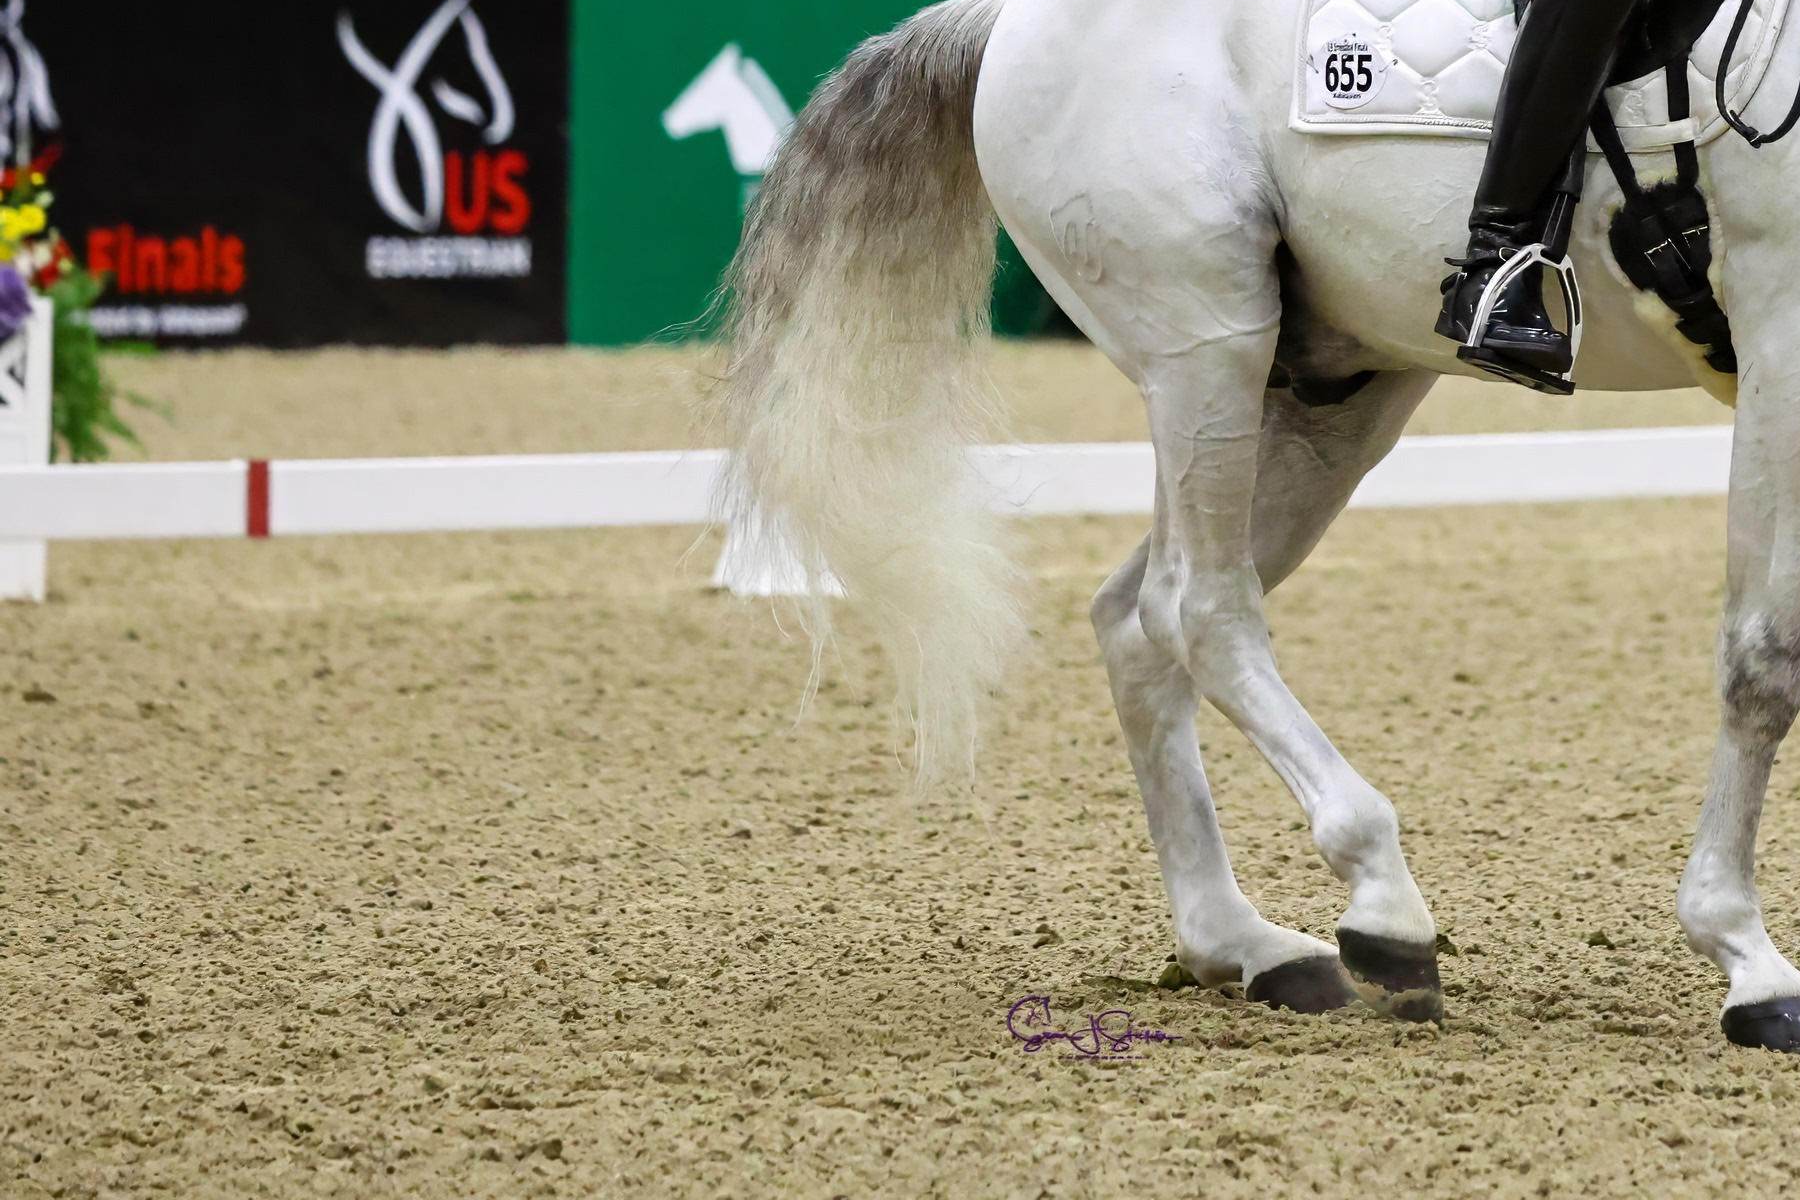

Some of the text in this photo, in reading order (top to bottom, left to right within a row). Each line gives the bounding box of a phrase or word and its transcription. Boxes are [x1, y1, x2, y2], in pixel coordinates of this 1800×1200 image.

[1325, 53, 1372, 93] 655
[446, 150, 531, 235] US
[87, 224, 245, 293] Finals
